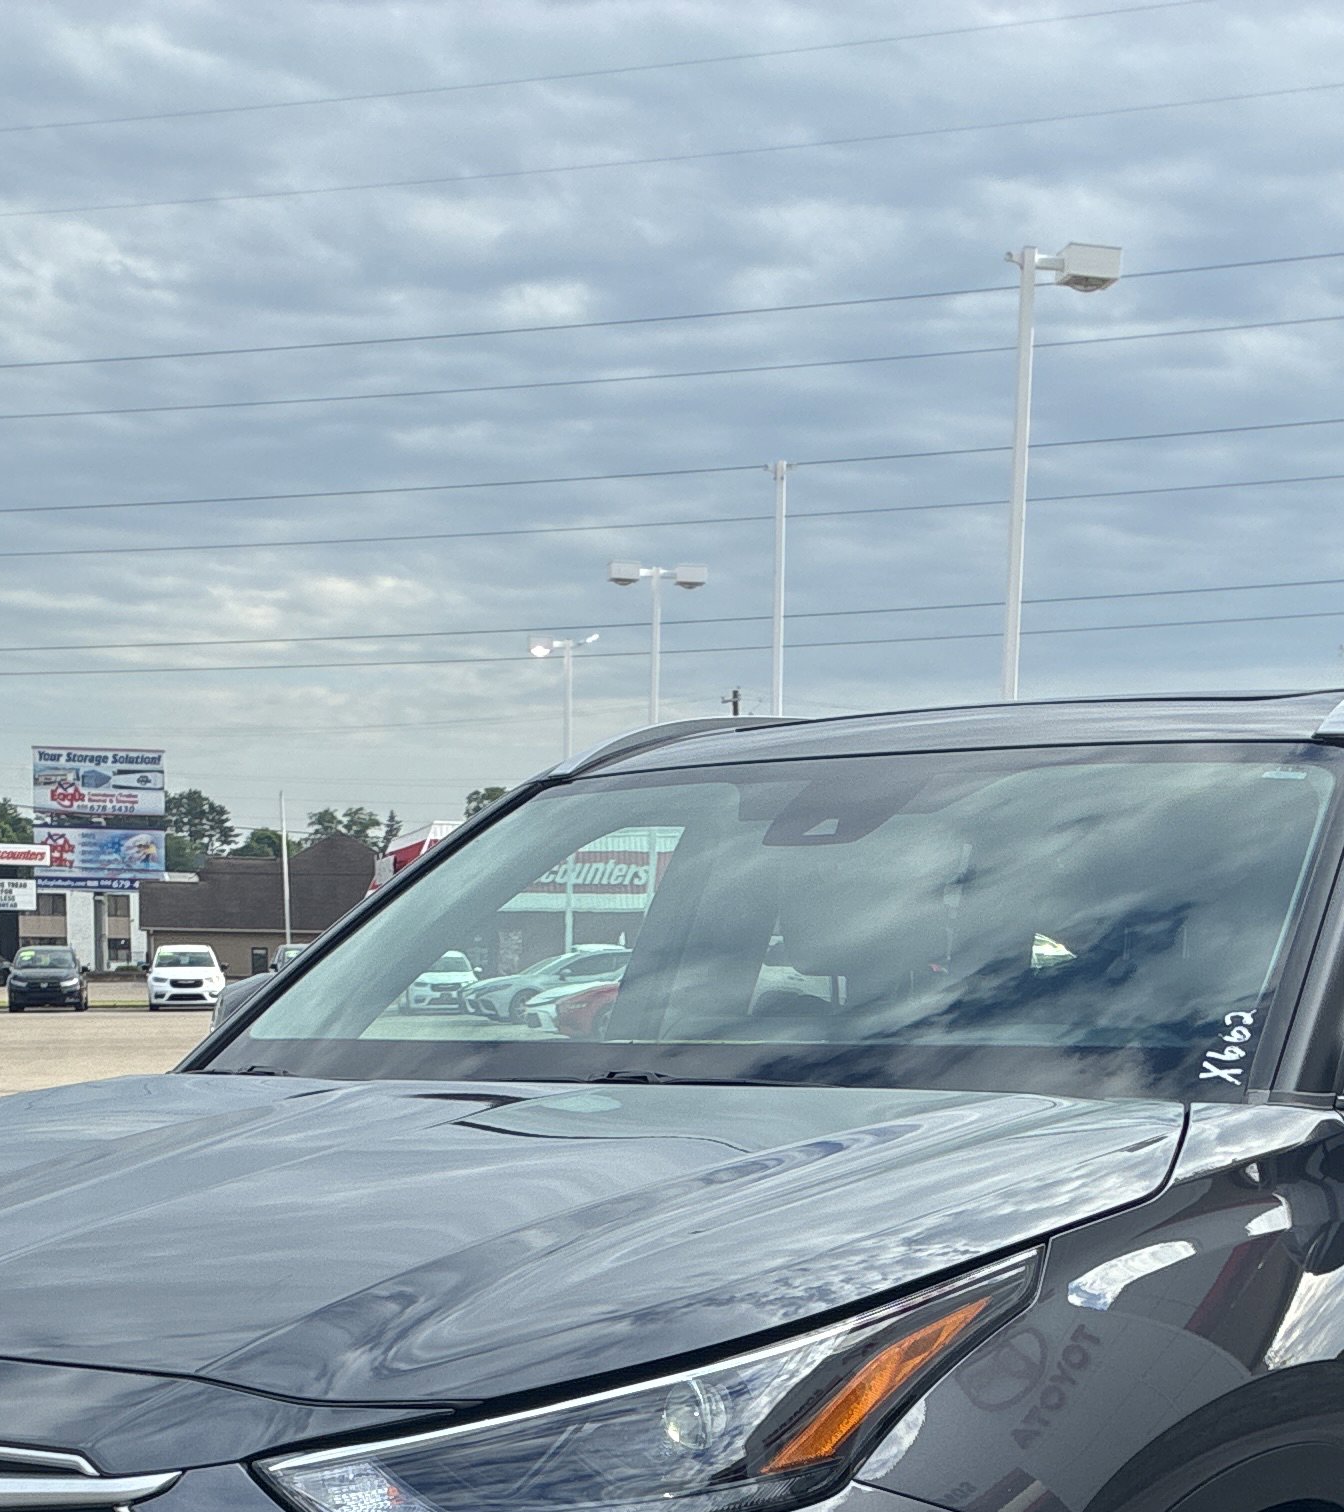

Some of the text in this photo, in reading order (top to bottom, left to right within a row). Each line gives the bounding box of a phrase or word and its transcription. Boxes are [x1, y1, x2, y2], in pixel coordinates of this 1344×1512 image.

[37, 750, 162, 766] Your Storage Solution!
[536, 859, 650, 886] counters
[112, 879, 140, 889] 679-4
